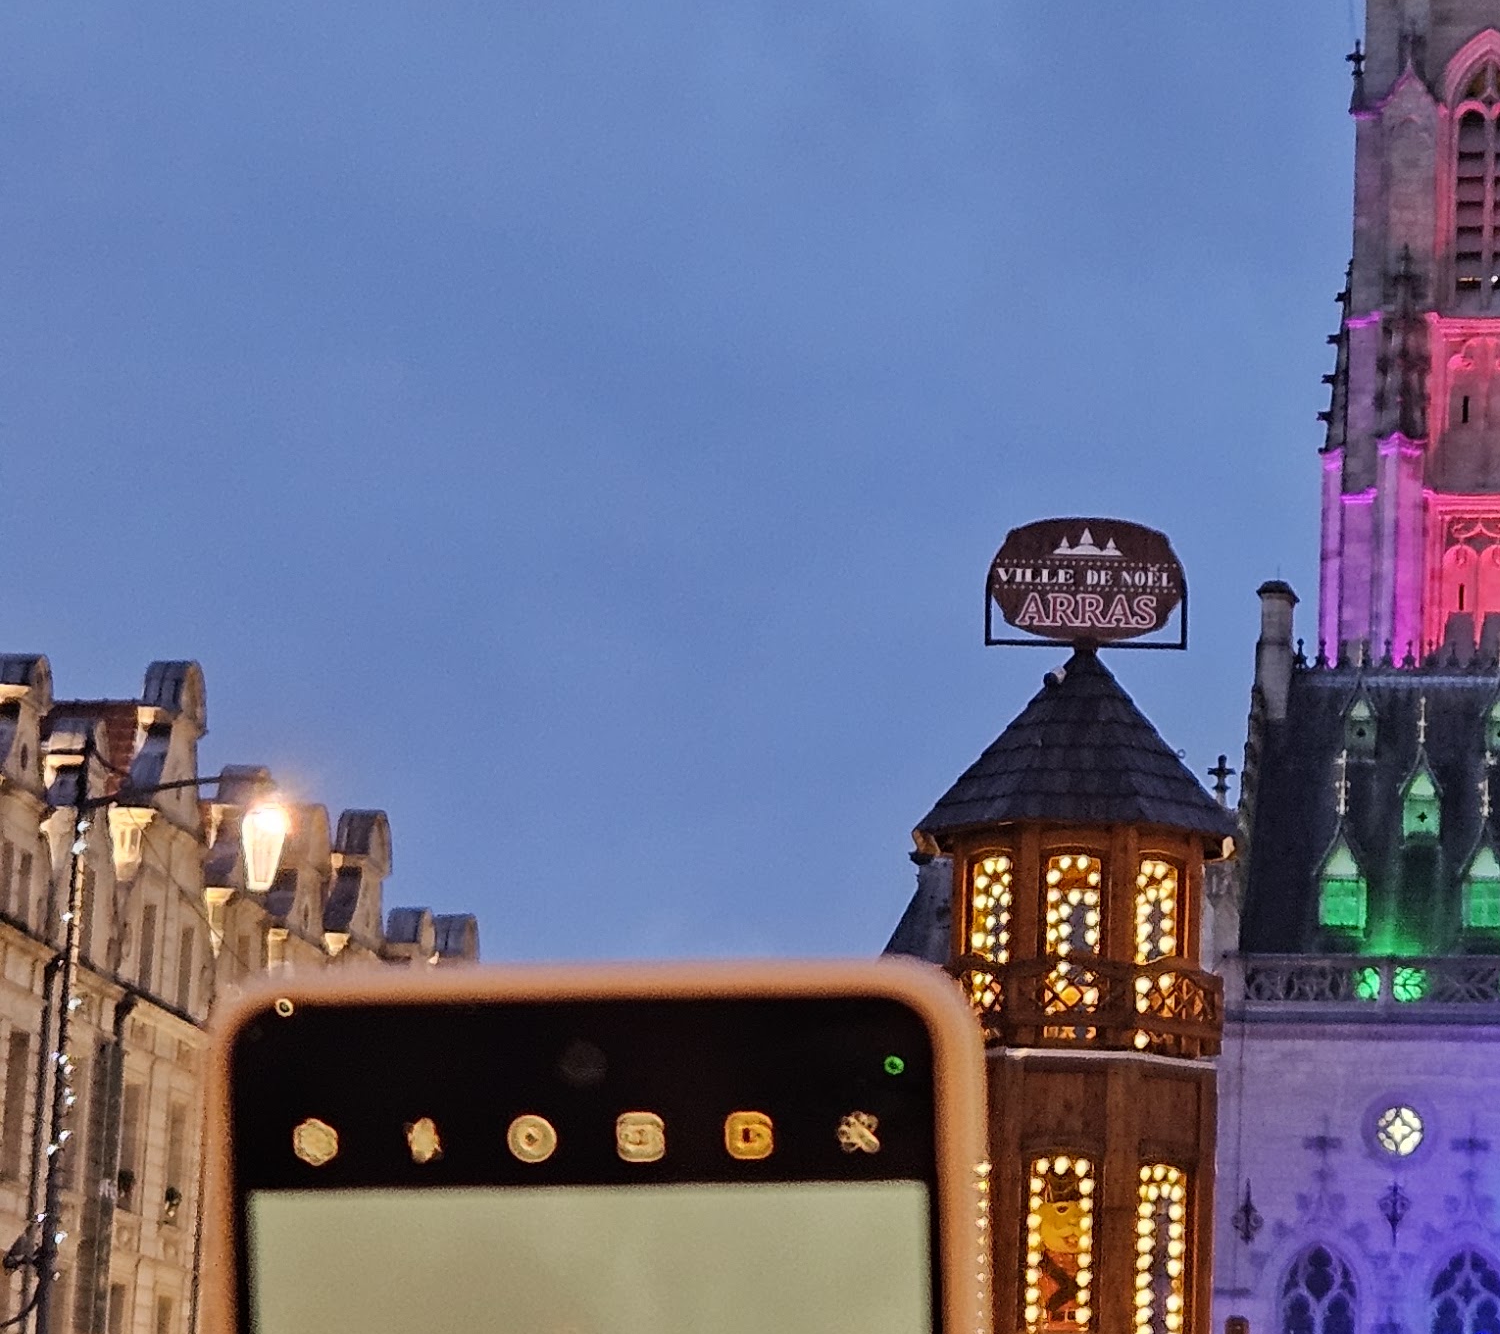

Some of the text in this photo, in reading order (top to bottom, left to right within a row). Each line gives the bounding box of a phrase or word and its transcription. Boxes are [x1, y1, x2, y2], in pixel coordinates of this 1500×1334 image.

[996, 567, 1174, 588] VILLE DE NOËL
[1015, 592, 1157, 628] ARRAS
